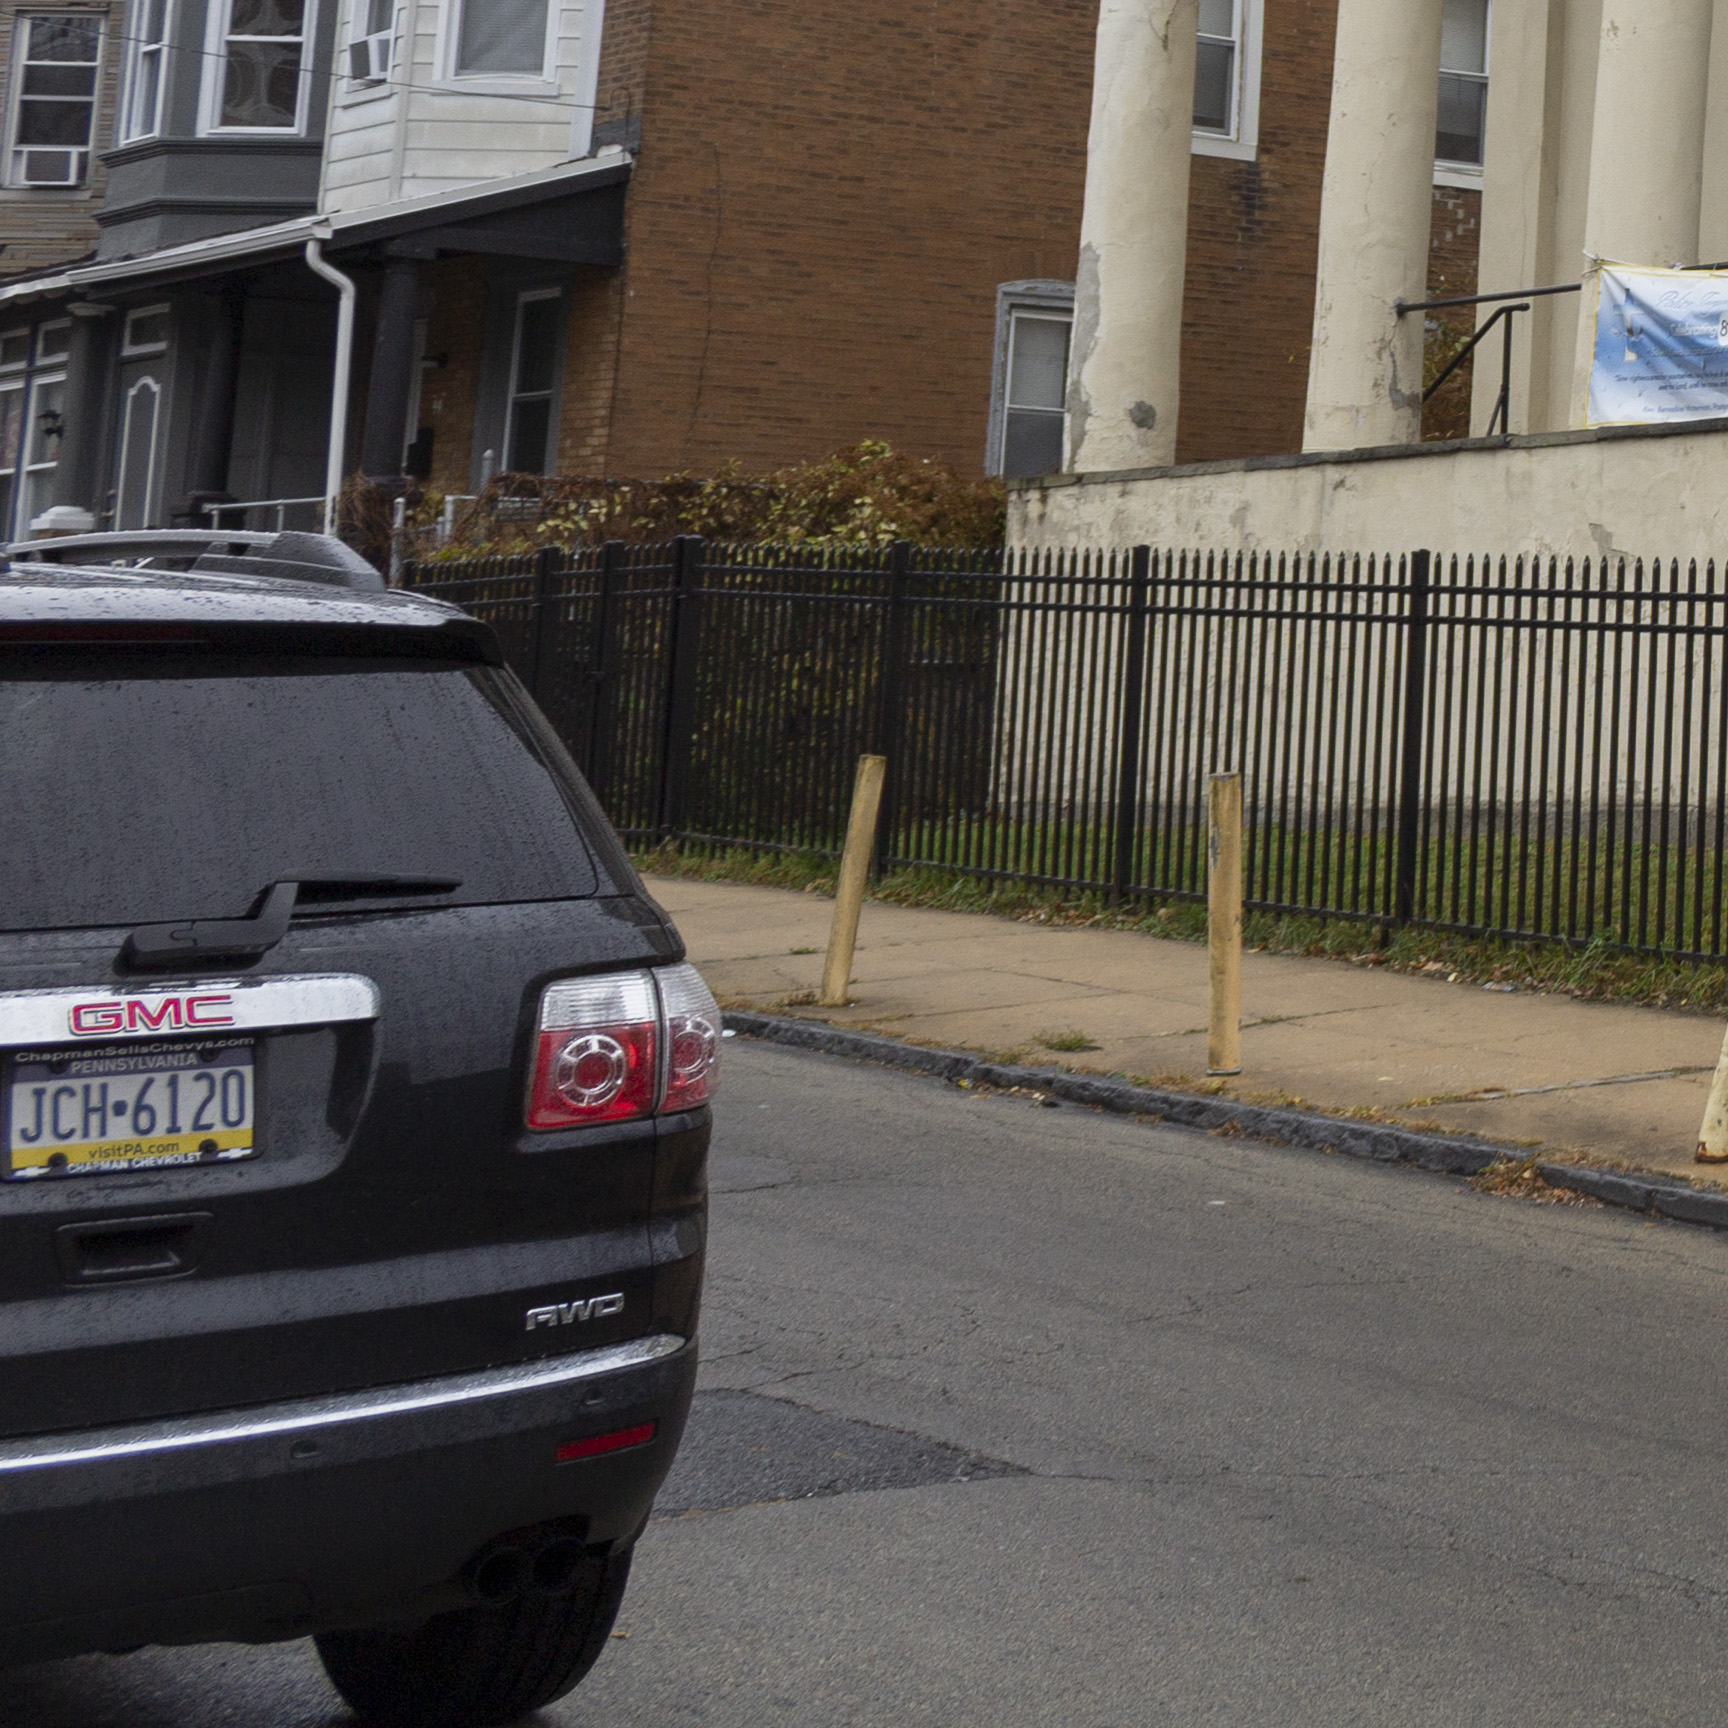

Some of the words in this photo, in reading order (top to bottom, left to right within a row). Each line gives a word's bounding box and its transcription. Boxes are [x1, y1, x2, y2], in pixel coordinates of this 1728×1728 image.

[70, 993, 236, 1036] GMC
[15, 1036, 255, 1063] ChapmanSellsChevys.com
[70, 1053, 199, 1074] PENNSYLVANIA
[66, 1157, 129, 1174] CHAPMAN
[131, 1150, 203, 1169] CHEVROLET
[88, 1141, 180, 1160] visitPA.com
[525, 1292, 625, 1331] AWD
